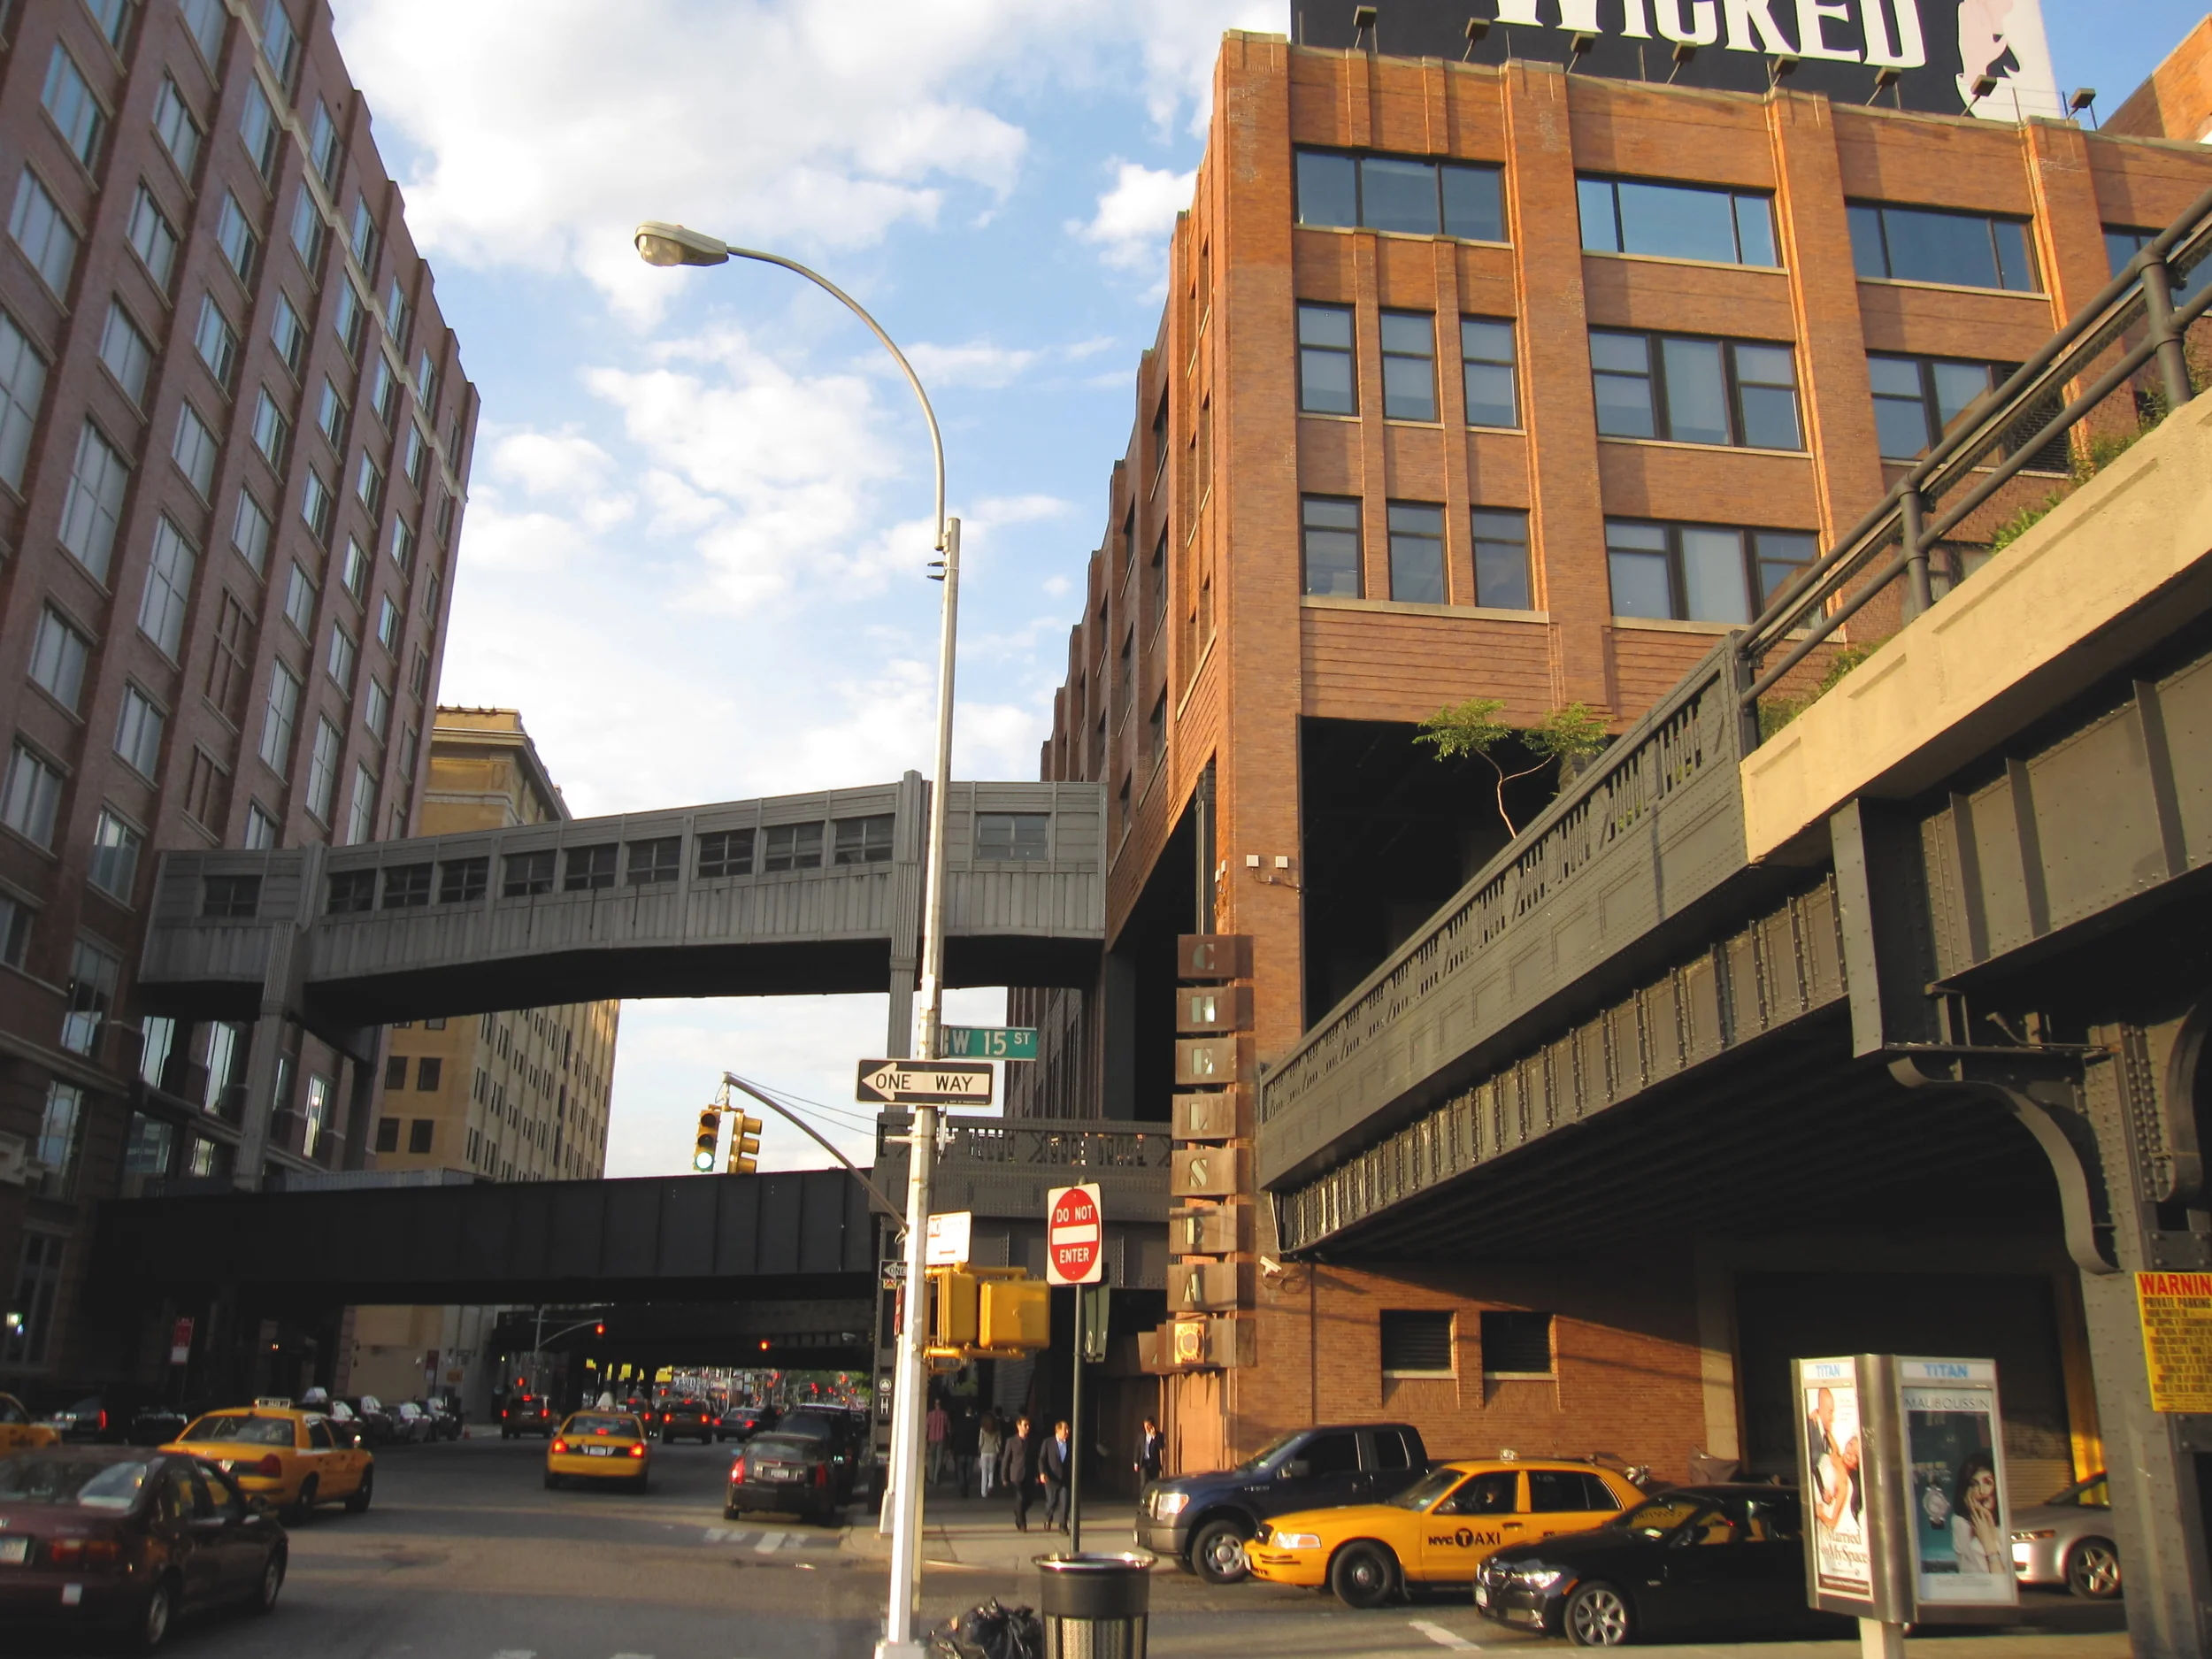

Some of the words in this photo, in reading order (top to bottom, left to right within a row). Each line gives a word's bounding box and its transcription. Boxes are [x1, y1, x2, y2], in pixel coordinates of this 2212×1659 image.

[952, 1030, 970, 1054] W
[984, 1031, 1007, 1056] 15
[1014, 1033, 1031, 1045] ST
[875, 1072, 911, 1091] ONE
[935, 1075, 972, 1093] WAY
[1183, 943, 1216, 1303] CHELSEA
[1056, 1208, 1069, 1223] DO
[1075, 1204, 1093, 1220] NOT
[1059, 1247, 1089, 1264] ENTER
[889, 1266, 905, 1275] ONE
[1816, 1363, 1840, 1378] TITAN
[1924, 1363, 1969, 1379] TITAN
[1905, 1397, 1990, 1410] MAUBOUSSIN
[1428, 1535, 1454, 1547] NYC
[1455, 1527, 1501, 1548] TAXI
